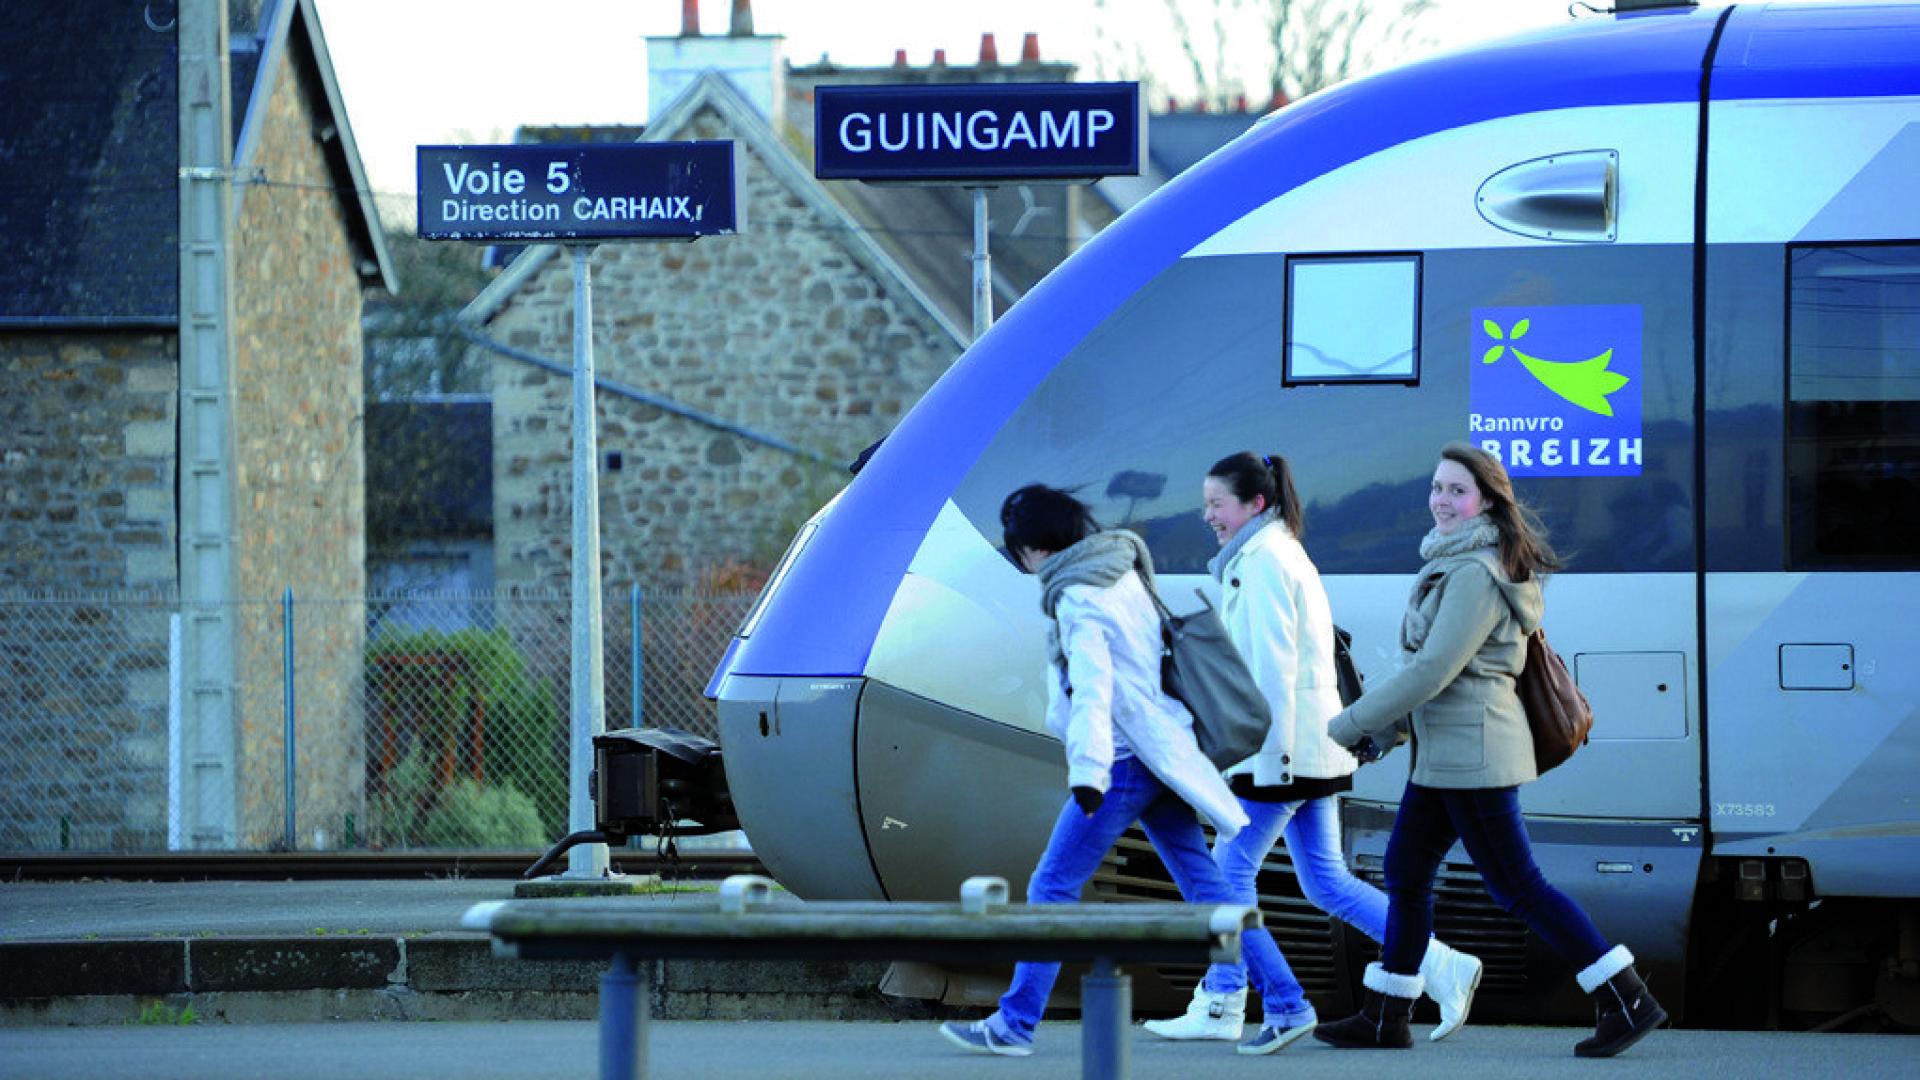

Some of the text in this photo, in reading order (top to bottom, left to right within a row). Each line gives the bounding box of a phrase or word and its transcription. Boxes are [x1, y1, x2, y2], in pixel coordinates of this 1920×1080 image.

[839, 109, 1115, 152] GUINGAMP
[443, 162, 570, 195] Voie 5
[443, 200, 560, 221] Direction
[1469, 413, 1564, 432] Rannvro
